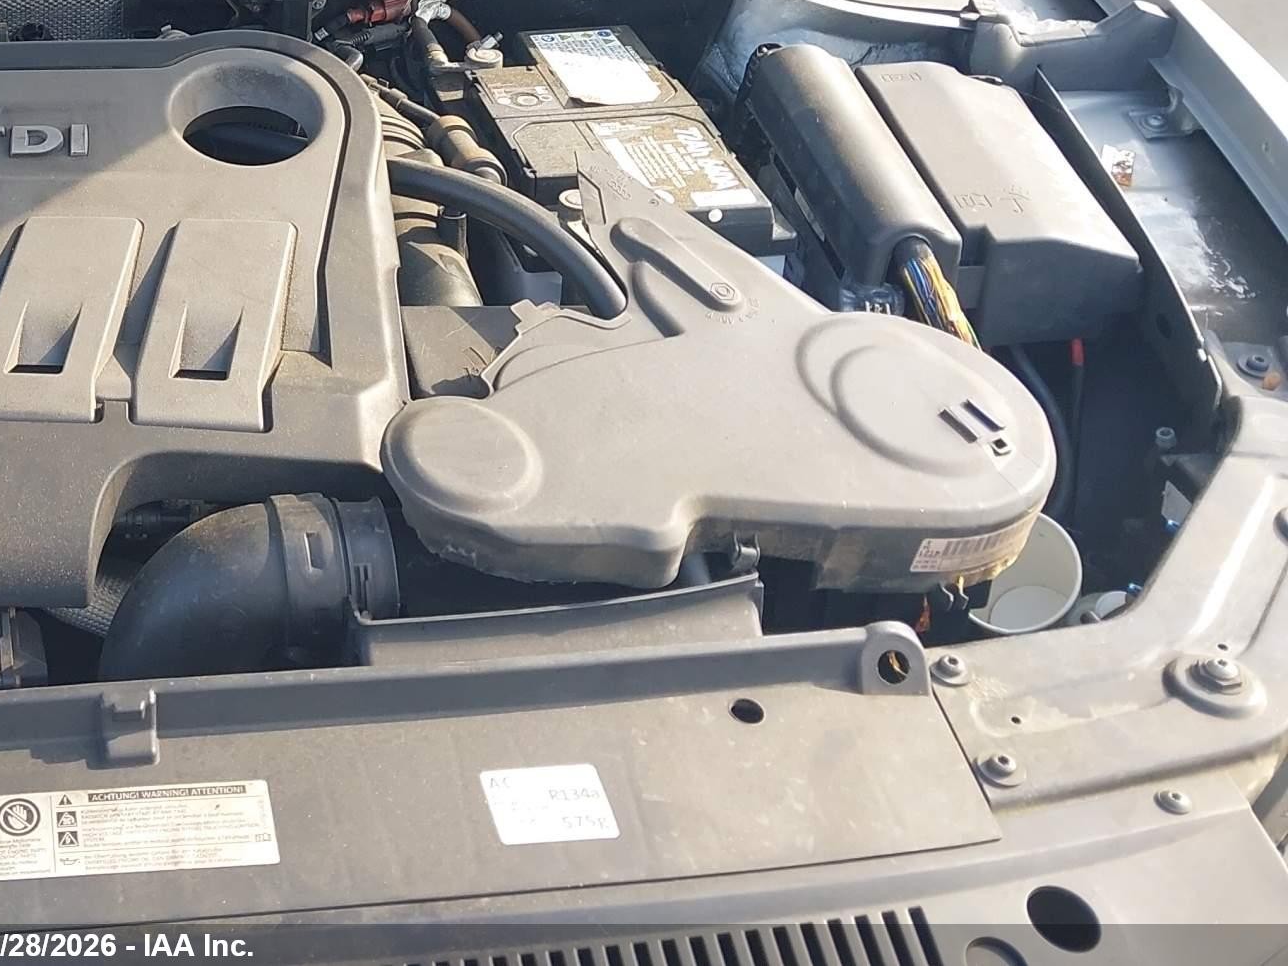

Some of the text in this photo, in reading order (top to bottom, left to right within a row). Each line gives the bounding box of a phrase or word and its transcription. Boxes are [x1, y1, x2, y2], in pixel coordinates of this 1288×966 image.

[489, 776, 512, 789] AC
[91, 785, 245, 802] ACHTUNG! WARNING! ATTENTION!
[548, 786, 601, 802] R134a
